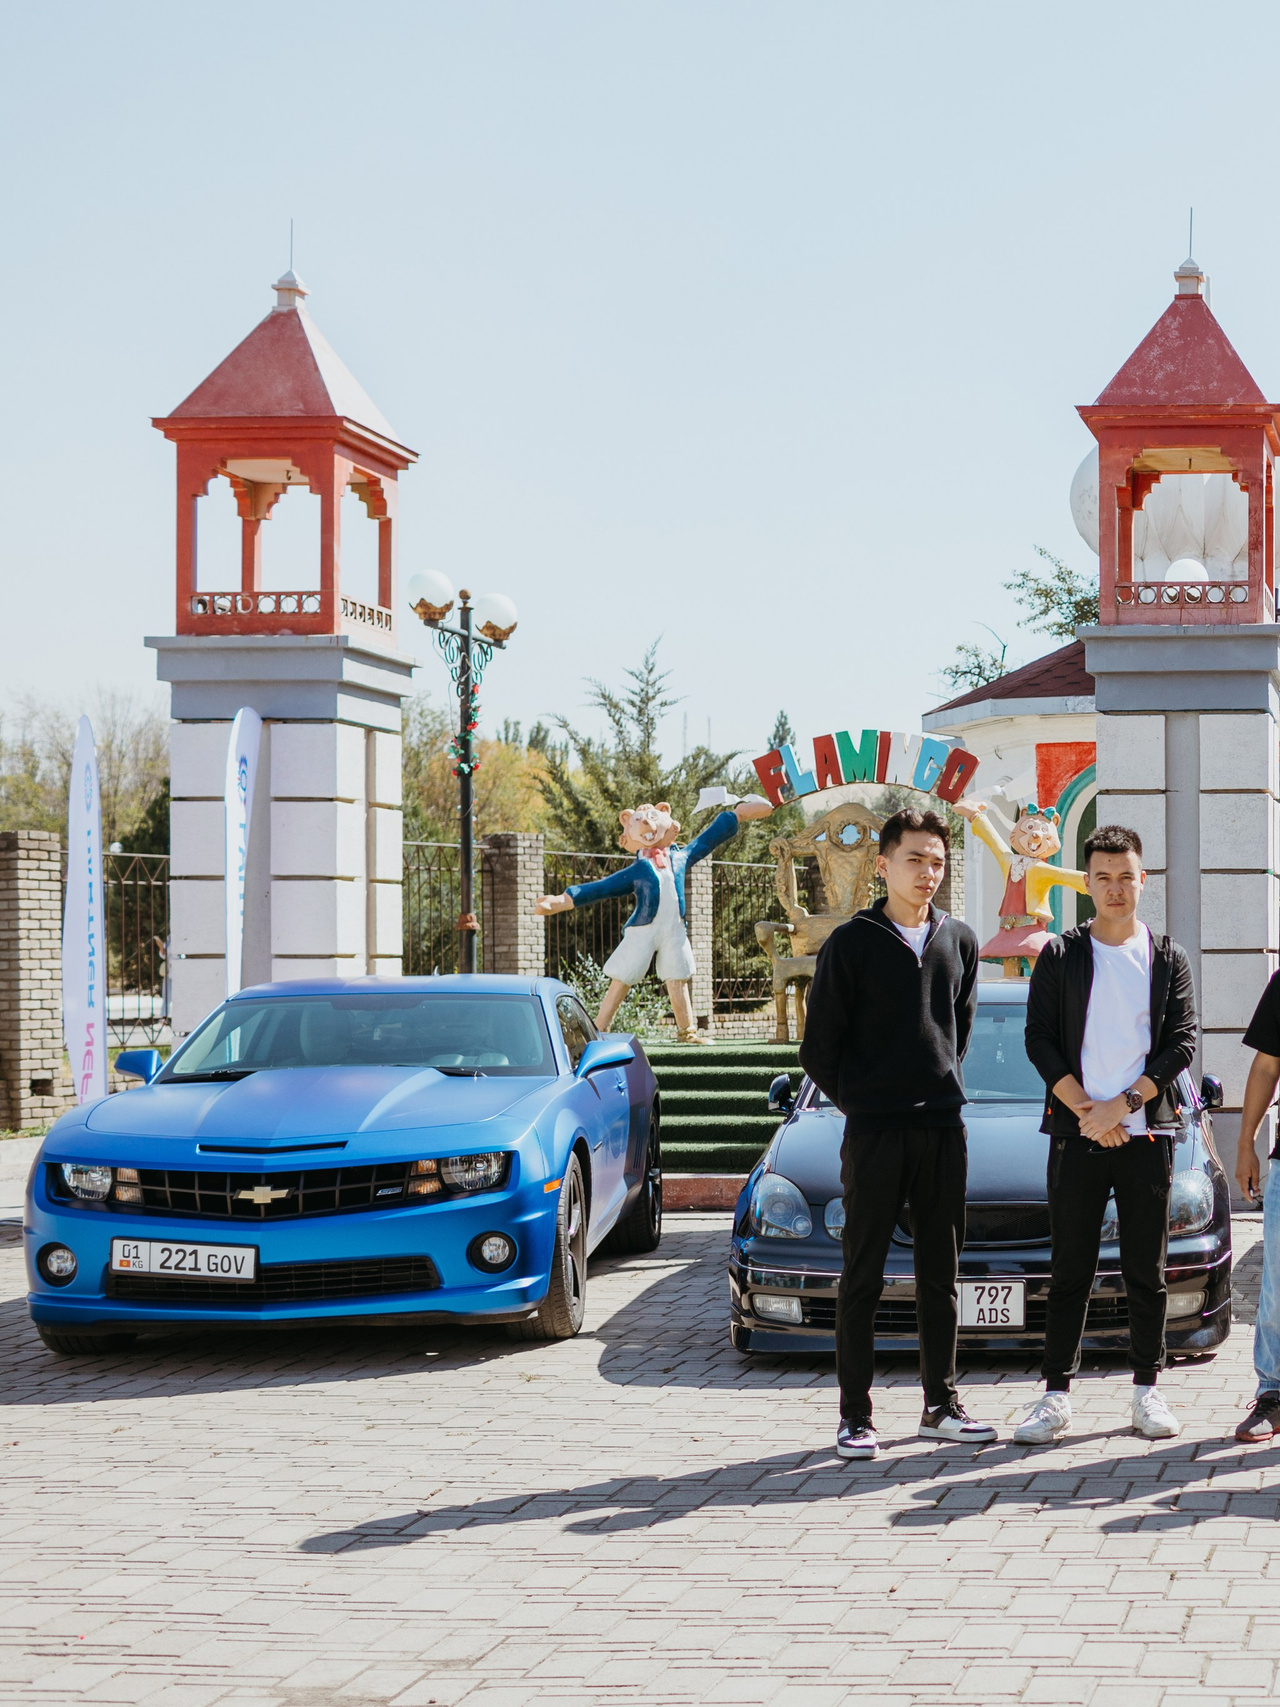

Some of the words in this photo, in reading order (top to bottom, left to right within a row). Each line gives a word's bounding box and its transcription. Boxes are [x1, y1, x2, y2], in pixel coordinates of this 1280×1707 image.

[752, 729, 981, 807] FLAMINGO
[122, 1244, 140, 1259] 01
[132, 1260, 143, 1269] KG
[159, 1247, 201, 1272] 221
[207, 1254, 245, 1274] GOV
[974, 1286, 1013, 1305] 797
[976, 1308, 1010, 1324] ADS
